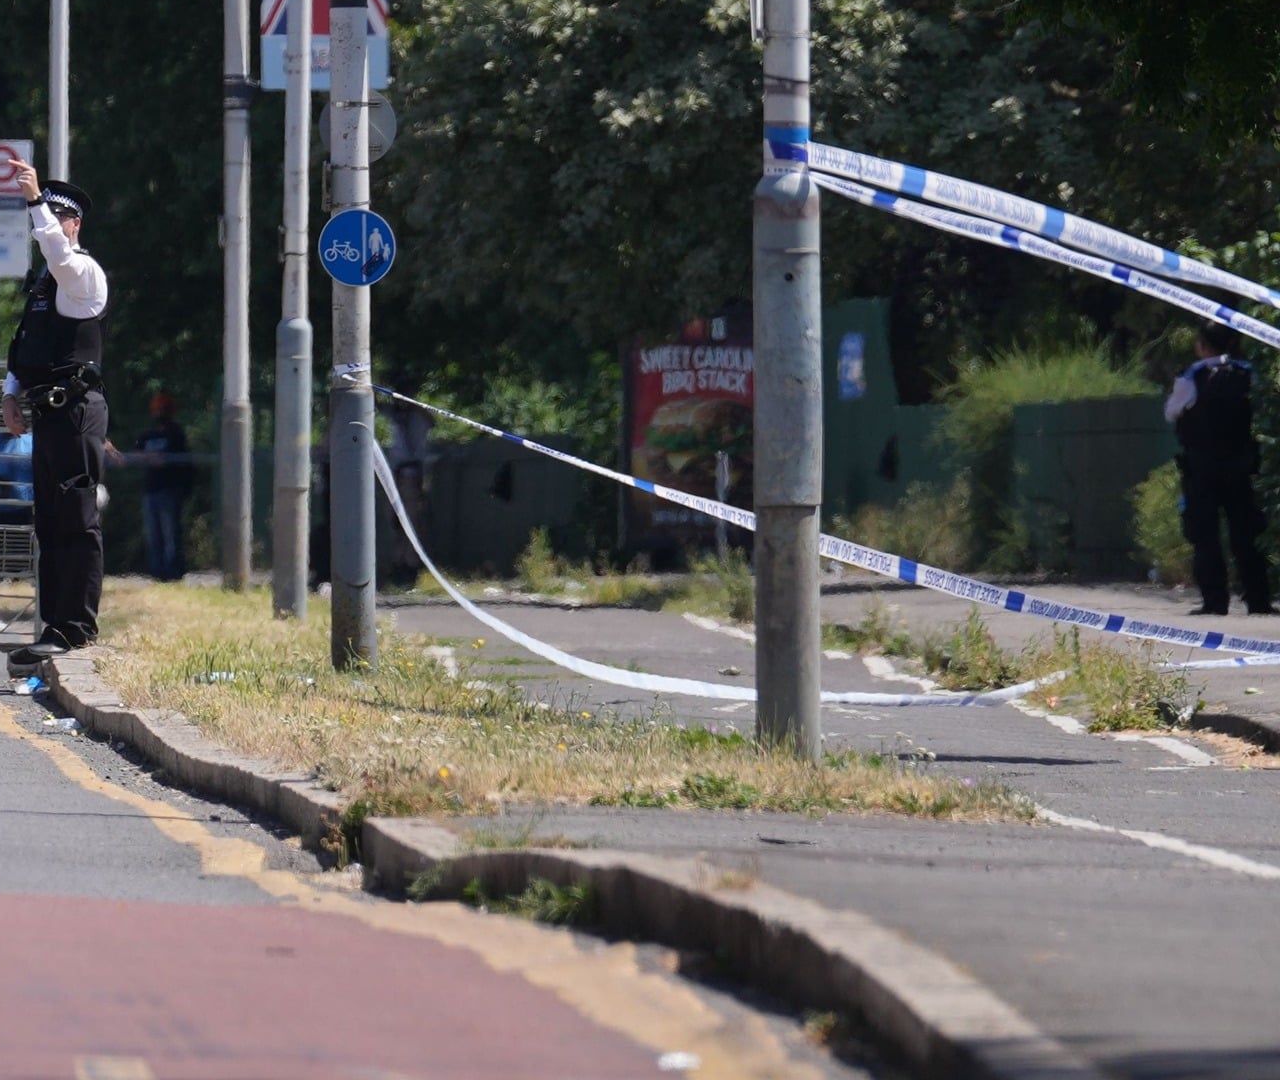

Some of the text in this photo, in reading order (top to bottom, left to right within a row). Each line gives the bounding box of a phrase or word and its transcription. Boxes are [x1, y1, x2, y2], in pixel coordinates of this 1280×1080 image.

[640, 345, 690, 373] SWEET
[662, 369, 747, 396] BBQ STACK
[826, 539, 840, 558] NOT
[841, 543, 852, 560] DO
[852, 547, 868, 565] LINE
[868, 552, 893, 572] POLICE
[924, 569, 1003, 604] POLICE LINE DO NOT CROSS
